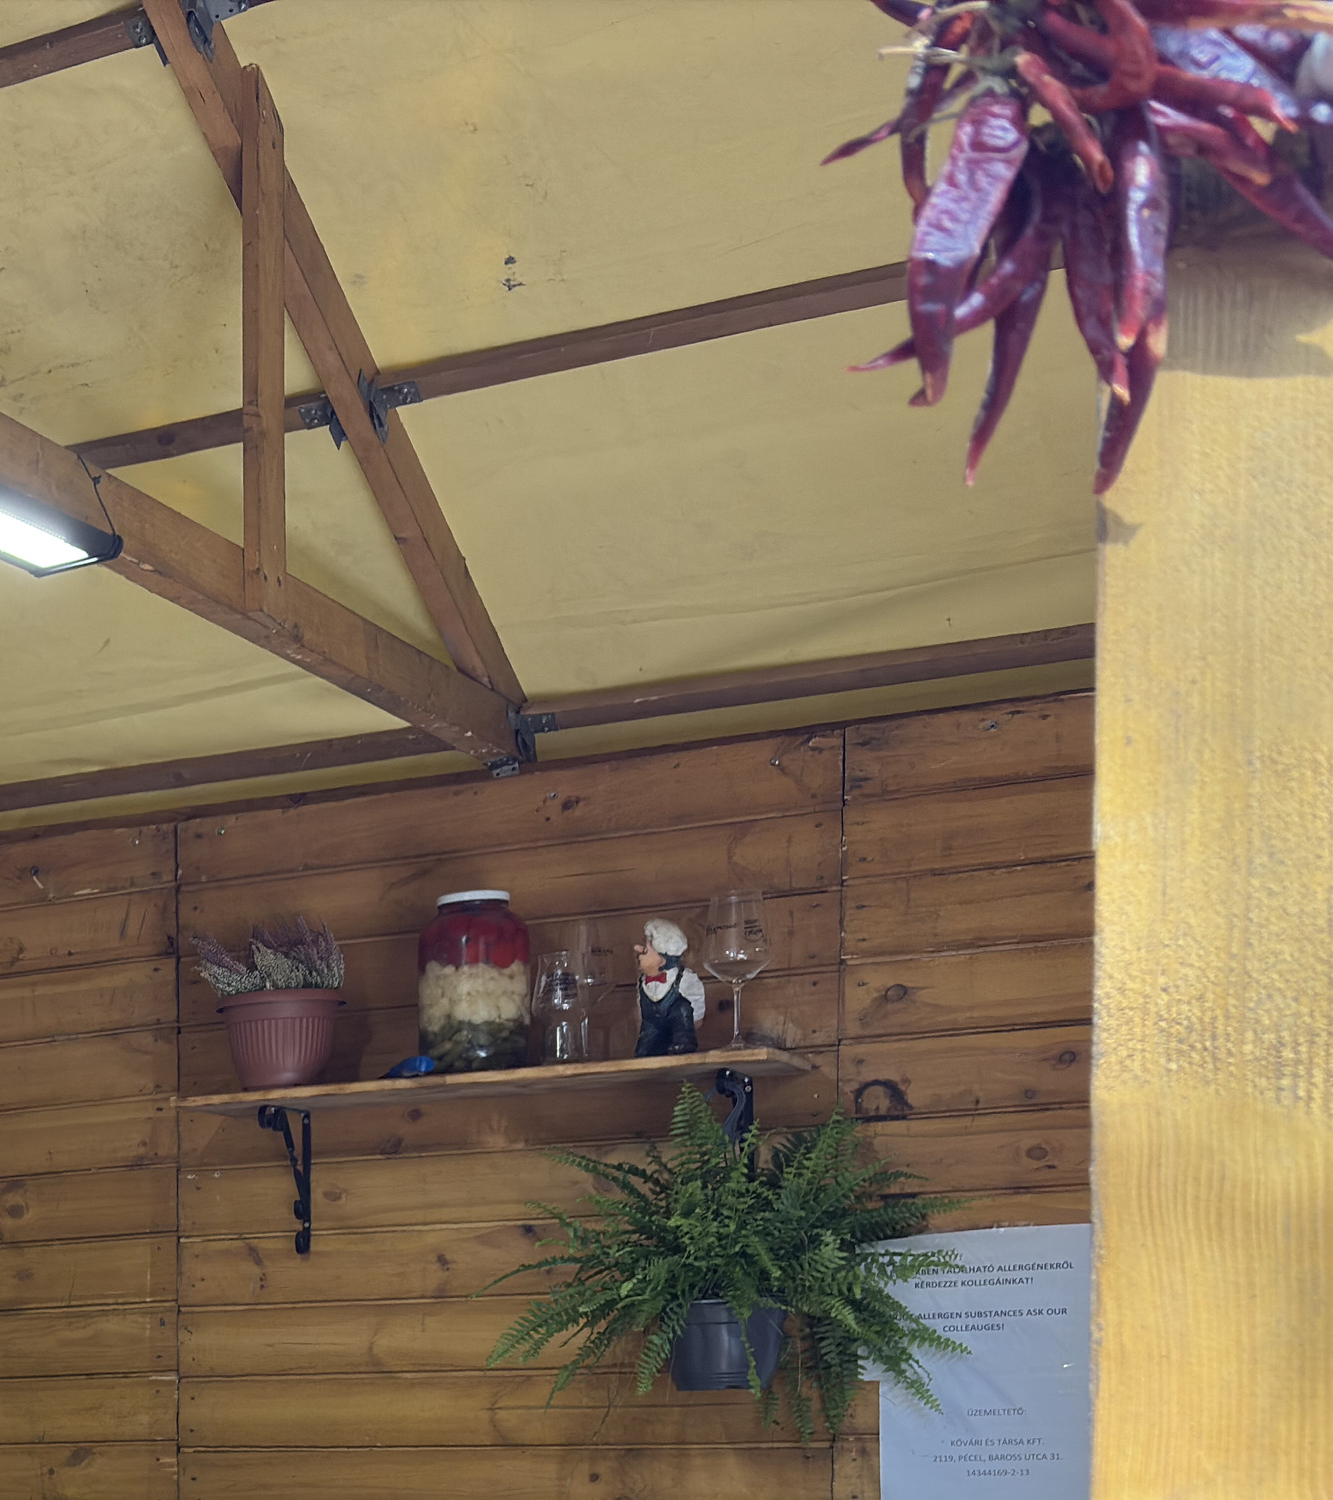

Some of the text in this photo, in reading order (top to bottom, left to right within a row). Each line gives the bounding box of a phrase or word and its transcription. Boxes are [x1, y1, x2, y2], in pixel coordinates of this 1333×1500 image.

[996, 1259, 1075, 1273] ALLERGÉNEKRŐL
[914, 1276, 1034, 1289] KÉRDEZZE KOLLEGÁINKAT!
[917, 1311, 962, 1321] ALLERGEN
[963, 1309, 1024, 1319] SUBSTANCES
[1026, 1308, 1044, 1317] ASK
[1046, 1307, 1068, 1317] OUR
[942, 1322, 1005, 1333] COLLEAUGES!
[984, 1437, 995, 1447] ÉS
[997, 1437, 1024, 1446] TÁRSA
[1026, 1437, 1045, 1446] KFT.
[958, 1453, 986, 1463] PÉCEL,
[988, 1453, 1023, 1462] BAROSS
[1024, 1452, 1048, 1461] UTCA
